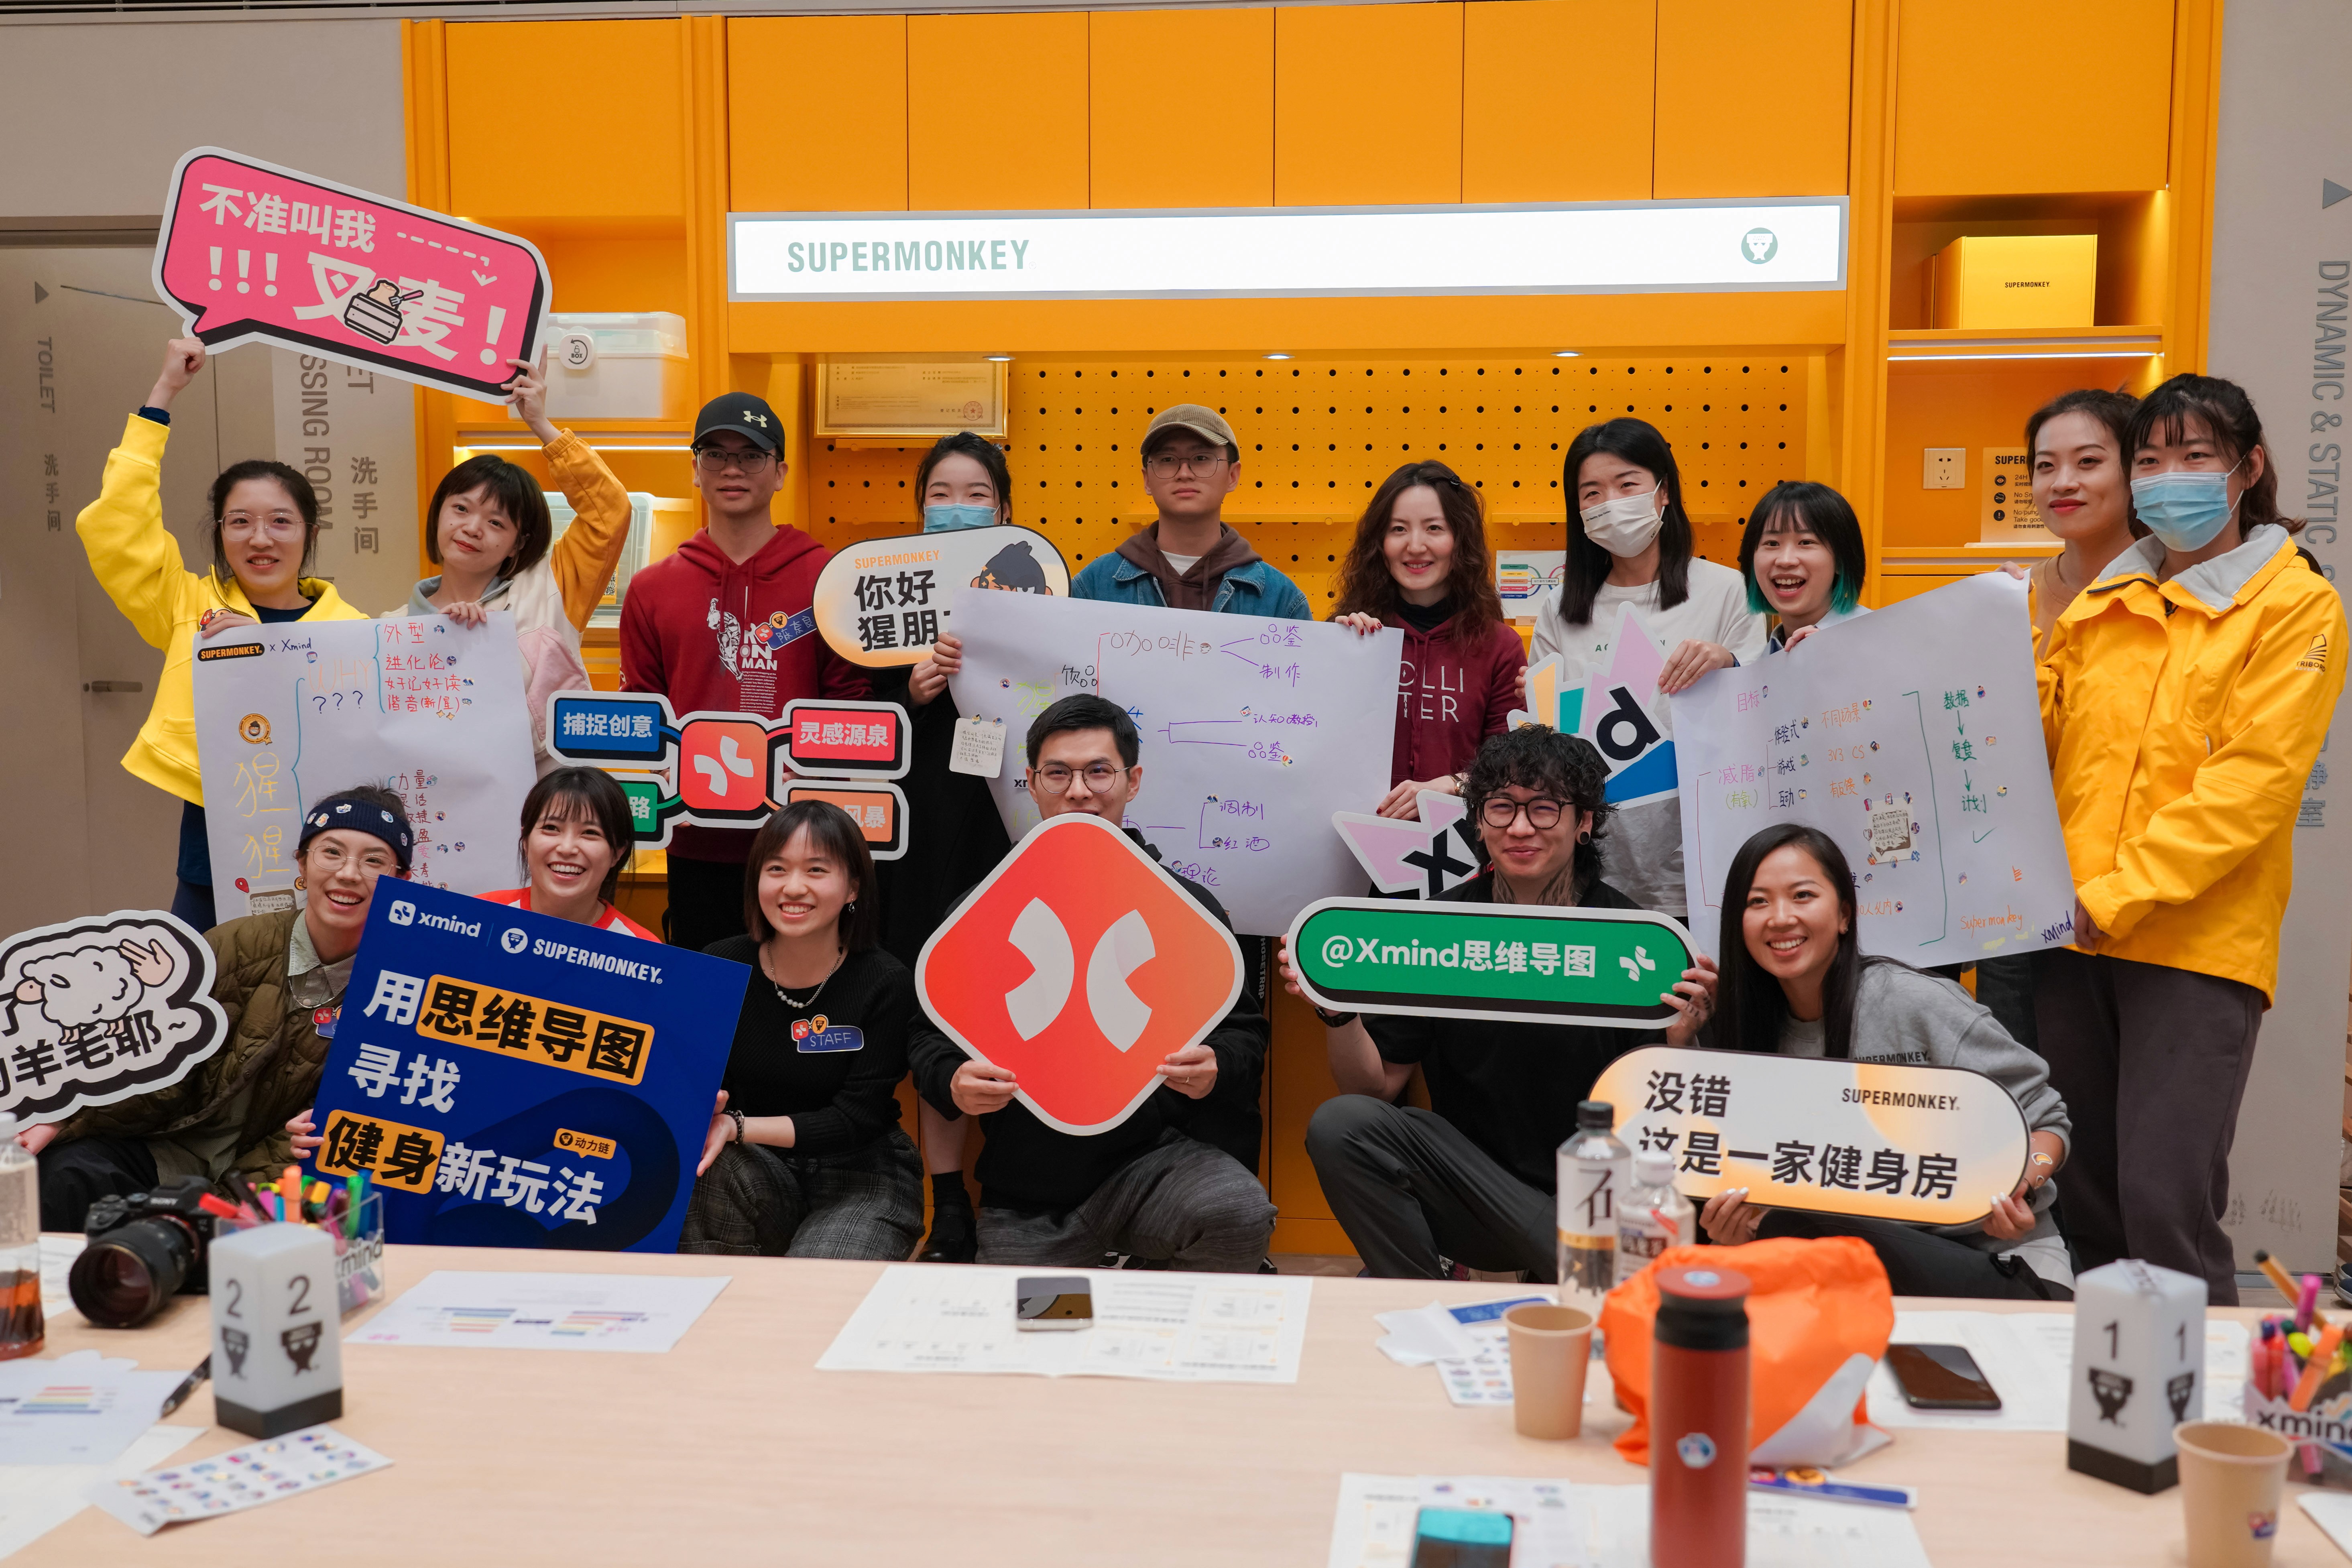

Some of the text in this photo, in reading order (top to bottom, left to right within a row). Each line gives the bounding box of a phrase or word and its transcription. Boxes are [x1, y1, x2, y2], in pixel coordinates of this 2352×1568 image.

[199, 183, 375, 252] 不准叫我
[788, 240, 1030, 272] SUPERMONKEY
[37, 337, 55, 413] TOILET
[2305, 261, 2350, 544] DYNAMIC & STATIC
[1995, 456, 2028, 464] SUPER
[45, 454, 61, 532] 洗手间
[350, 456, 379, 553] 洗手间
[855, 550, 940, 569] SUPERMONKEY
[854, 569, 936, 612] 你好
[384, 623, 424, 645] 外型
[858, 608, 950, 652] 猩朋
[201, 645, 261, 659] SUPERMONKEY
[282, 637, 311, 652] Xmind
[1111, 630, 1195, 661] 咖啡
[385, 653, 445, 671] 进化论
[742, 658, 778, 671] MAN
[1259, 663, 1301, 687] 制作
[2297, 661, 2326, 672] TRIBORD
[308, 659, 373, 694] WHY
[385, 673, 461, 691] 好记好读
[1738, 691, 1760, 712] 目标
[1943, 689, 1969, 710] 数据
[563, 712, 653, 738] 捕捉创意
[1822, 703, 1861, 728] 不同场景
[798, 721, 889, 747] 灵感源泉
[1852, 745, 1865, 759] CS
[399, 770, 428, 790] 力量
[1719, 763, 1754, 785] 减脂
[1778, 788, 1795, 808] 互动
[1962, 794, 1986, 813] 计划
[418, 911, 662, 983] xmind SUPERMONKEY
[1322, 935, 1596, 978] @Xmind思维导图
[363, 970, 646, 1079] 用思维导图
[810, 1032, 851, 1047] STAFF
[1854, 1050, 1928, 1063] ERMONKEY
[348, 1042, 461, 1113] 寻找
[1645, 1070, 1731, 1118] 没错
[1842, 1088, 1958, 1110] SUPERMONKEY
[575, 1137, 610, 1155] 动力链
[324, 1110, 604, 1225] 健身新玩法
[336, 1233, 383, 1277] mind
[226, 1277, 242, 1318] 2
[288, 1275, 312, 1316] 2
[2103, 1319, 2119, 1360] 1
[2174, 1321, 2186, 1362] 1
